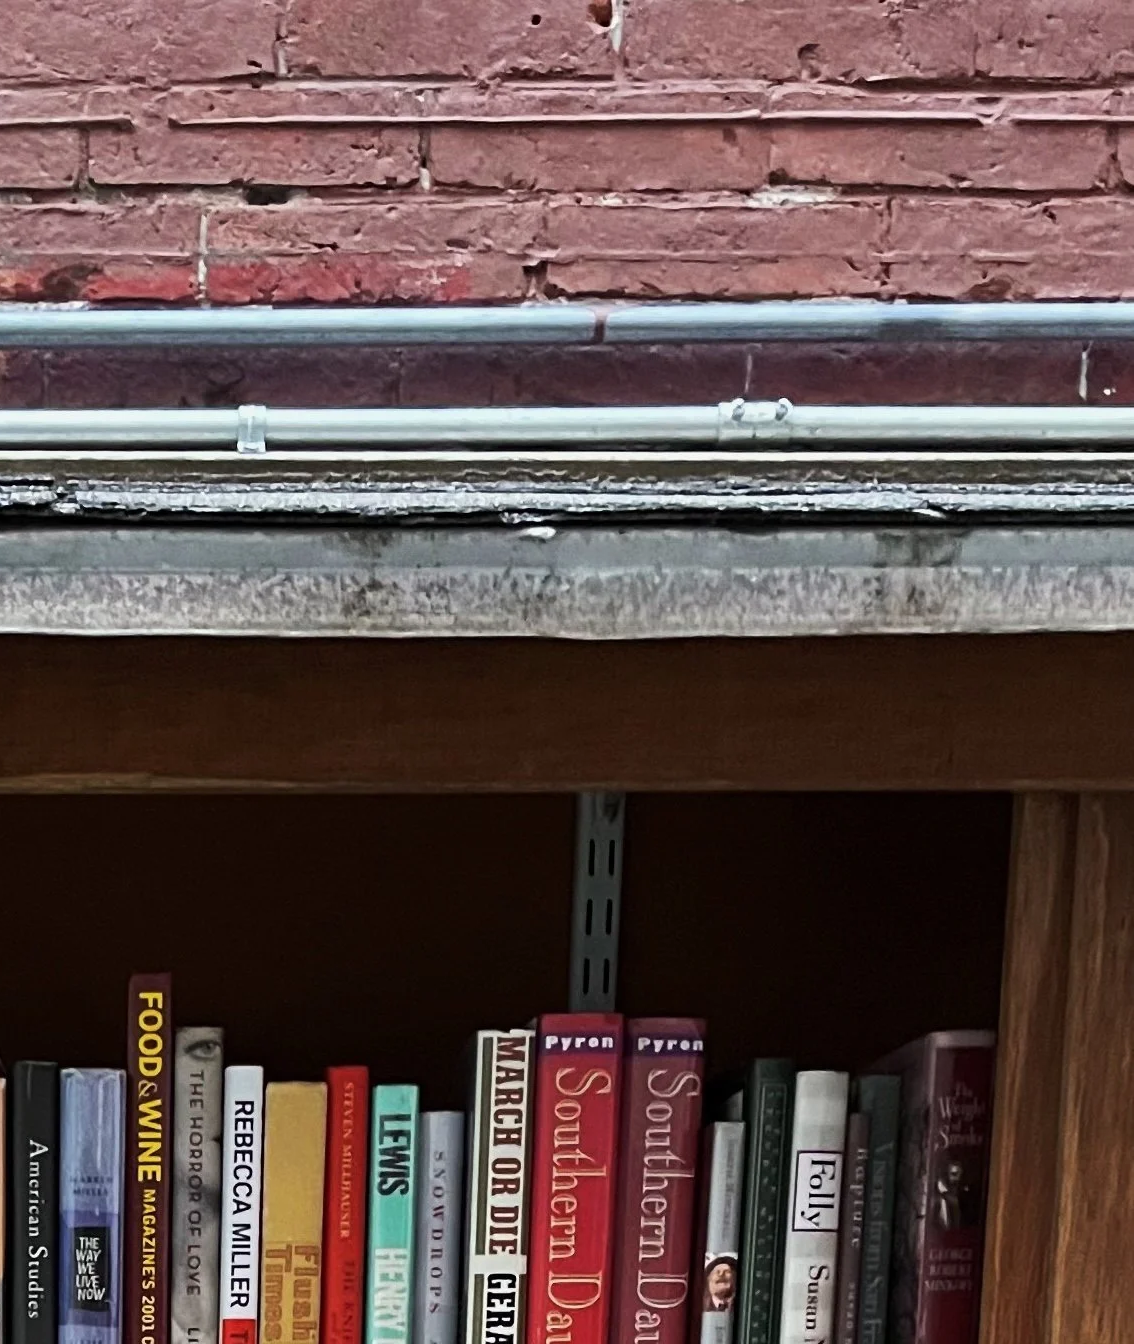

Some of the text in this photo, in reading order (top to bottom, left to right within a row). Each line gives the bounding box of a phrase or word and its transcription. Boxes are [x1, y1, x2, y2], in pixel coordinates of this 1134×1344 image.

[137, 992, 163, 1182] FOOD&WINE
[490, 1036, 526, 1255] MARCH OR DIE
[229, 1100, 254, 1307] REBECCA MILLER
[549, 1067, 610, 1262] Southern
[800, 1158, 835, 1229] Folly
[141, 1189, 157, 1289] MAGAZINE'S
[805, 1265, 830, 1330] Susan
[142, 1295, 155, 1332] 2001
